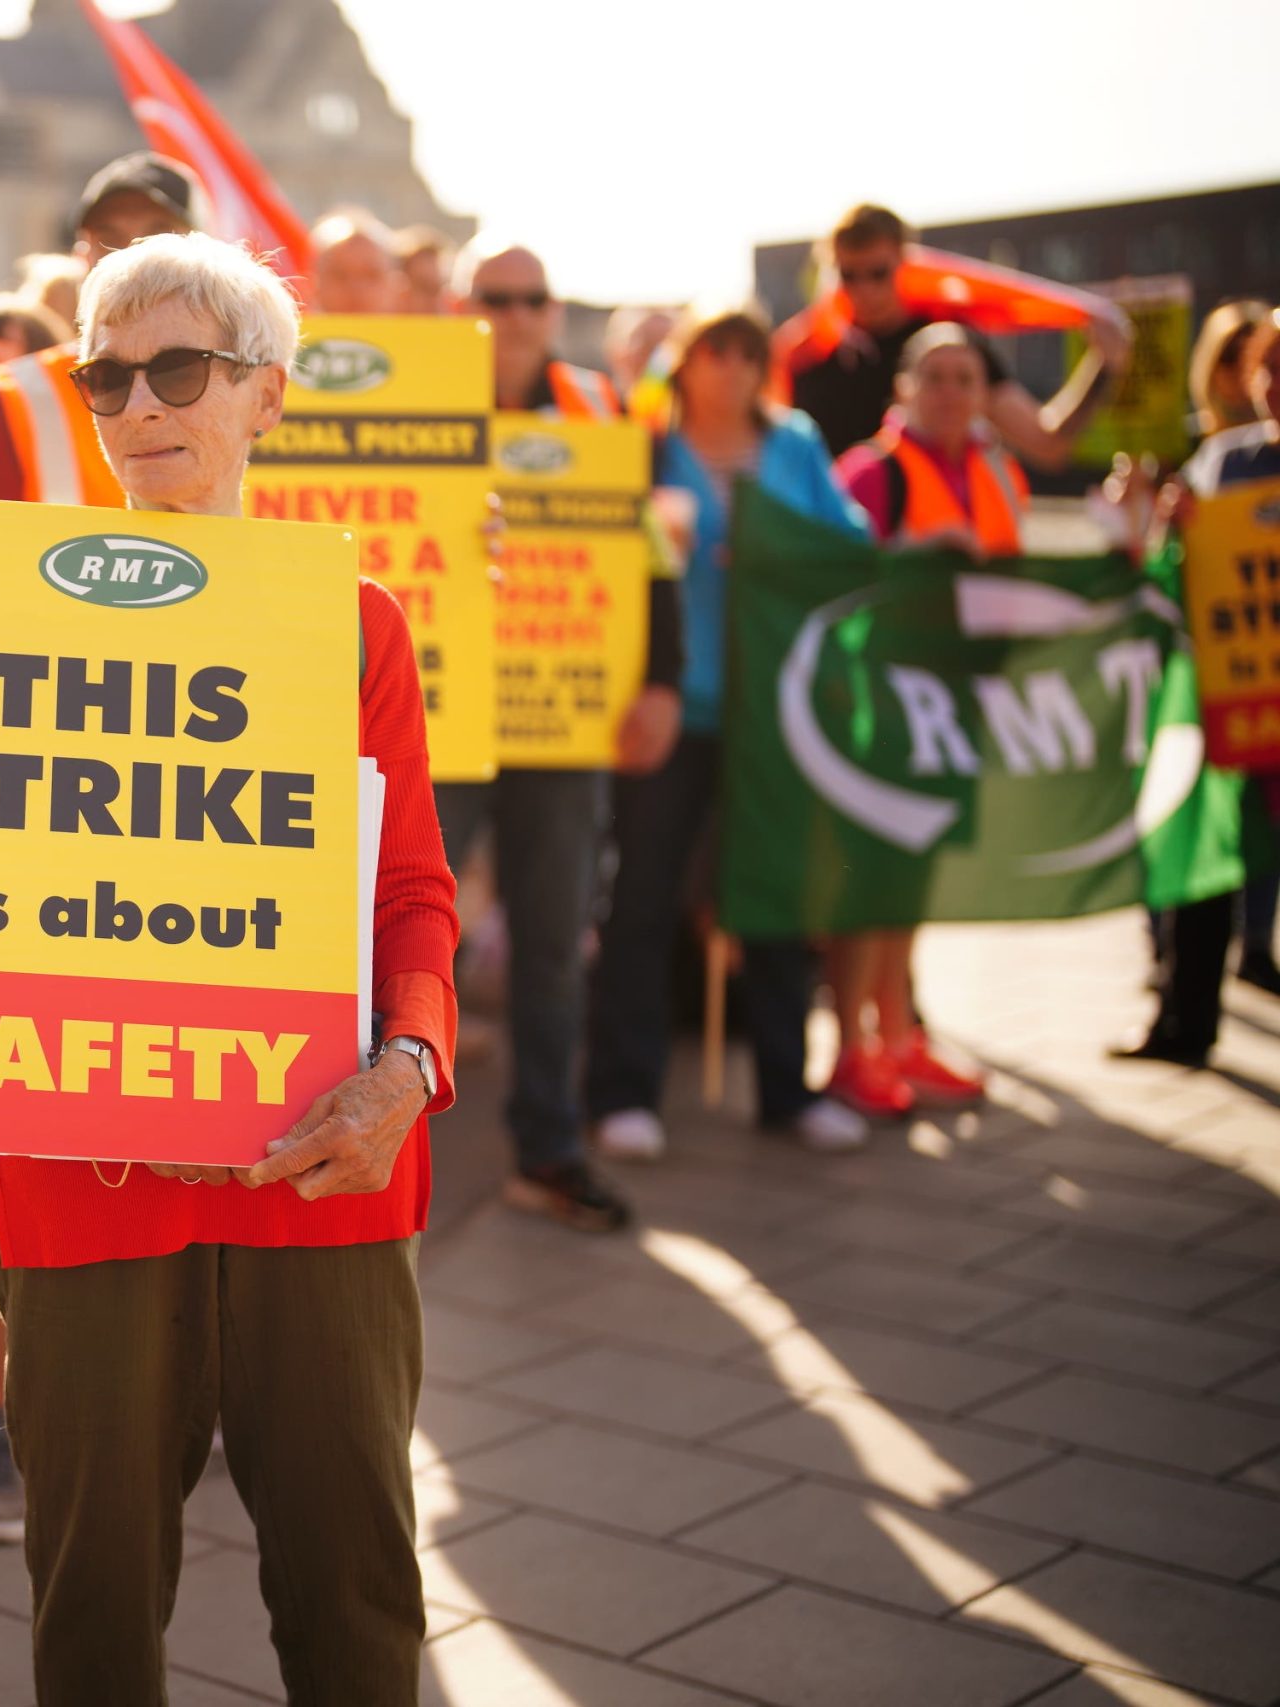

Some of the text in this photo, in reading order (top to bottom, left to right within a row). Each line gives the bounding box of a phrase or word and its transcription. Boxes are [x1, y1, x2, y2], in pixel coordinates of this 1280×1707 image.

[356, 421, 478, 456] PICKET
[253, 486, 418, 523] NEVER
[78, 556, 174, 587] RMT
[888, 639, 1164, 778] RMT
[38, 880, 282, 950] about
